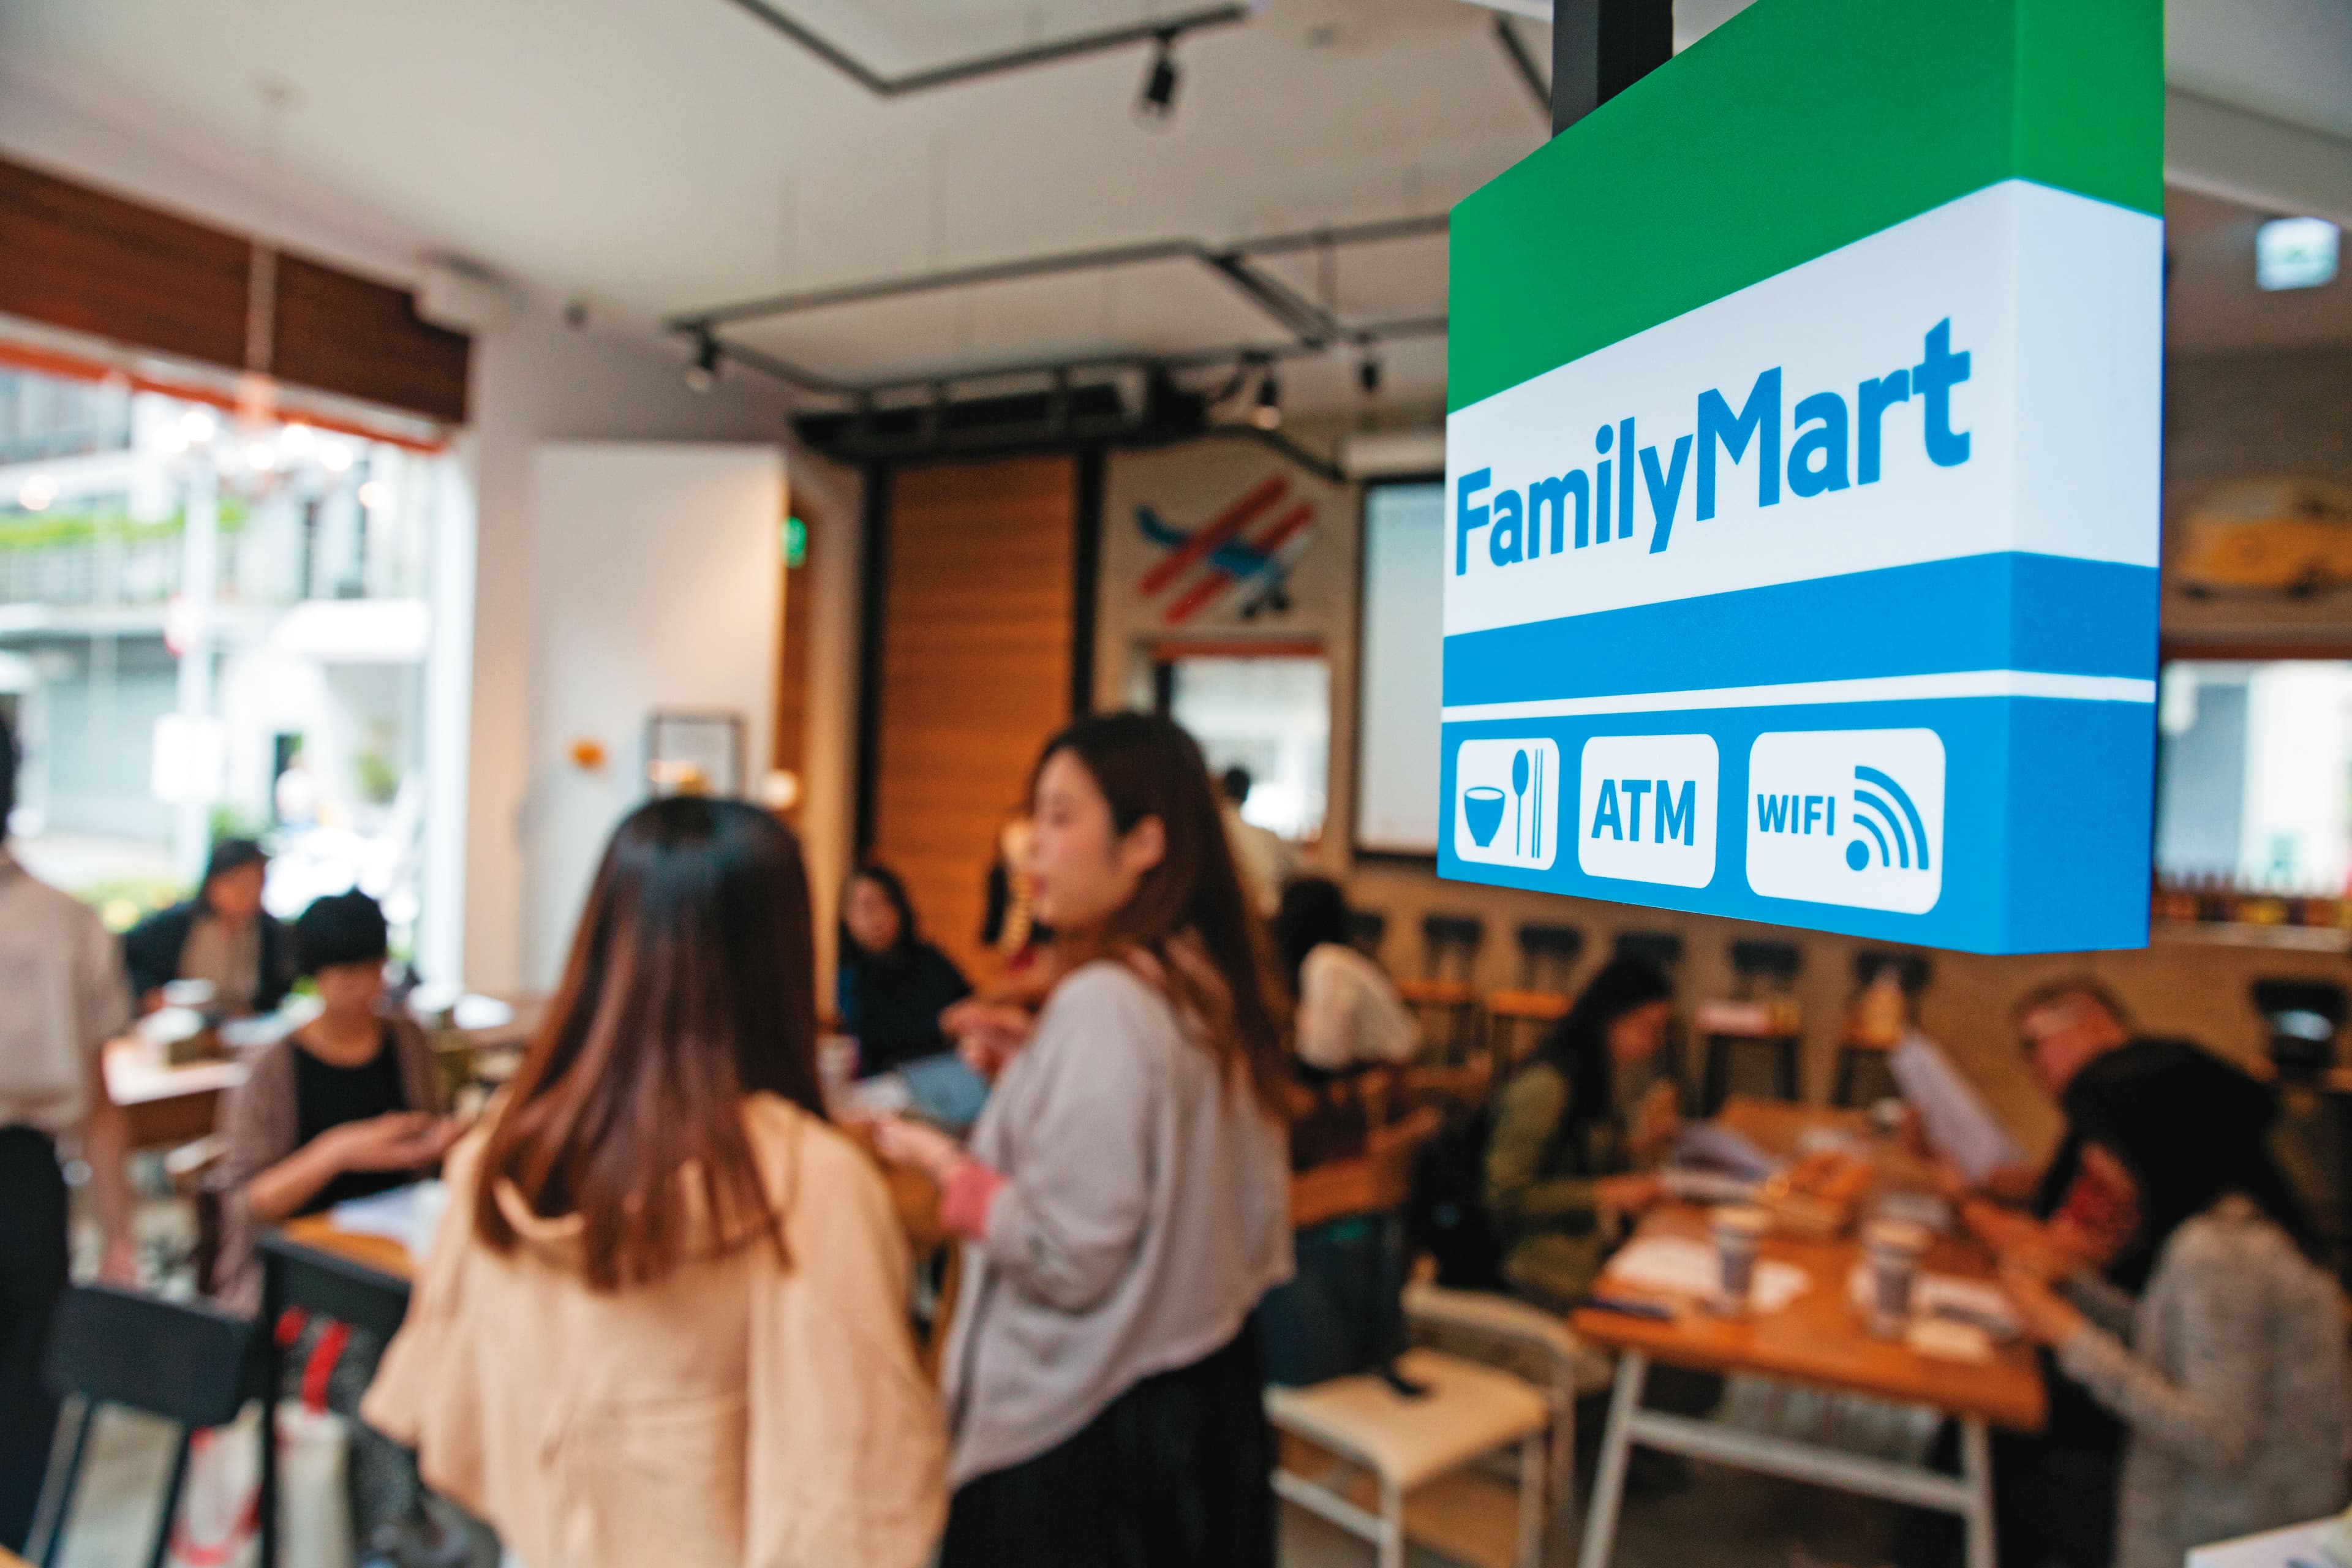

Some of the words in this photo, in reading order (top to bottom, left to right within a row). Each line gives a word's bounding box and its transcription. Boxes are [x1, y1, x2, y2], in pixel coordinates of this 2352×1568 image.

[1455, 317, 1972, 576] FamilyMart
[1591, 778, 1697, 846] ATM
[1757, 794, 1836, 836] WIFI
